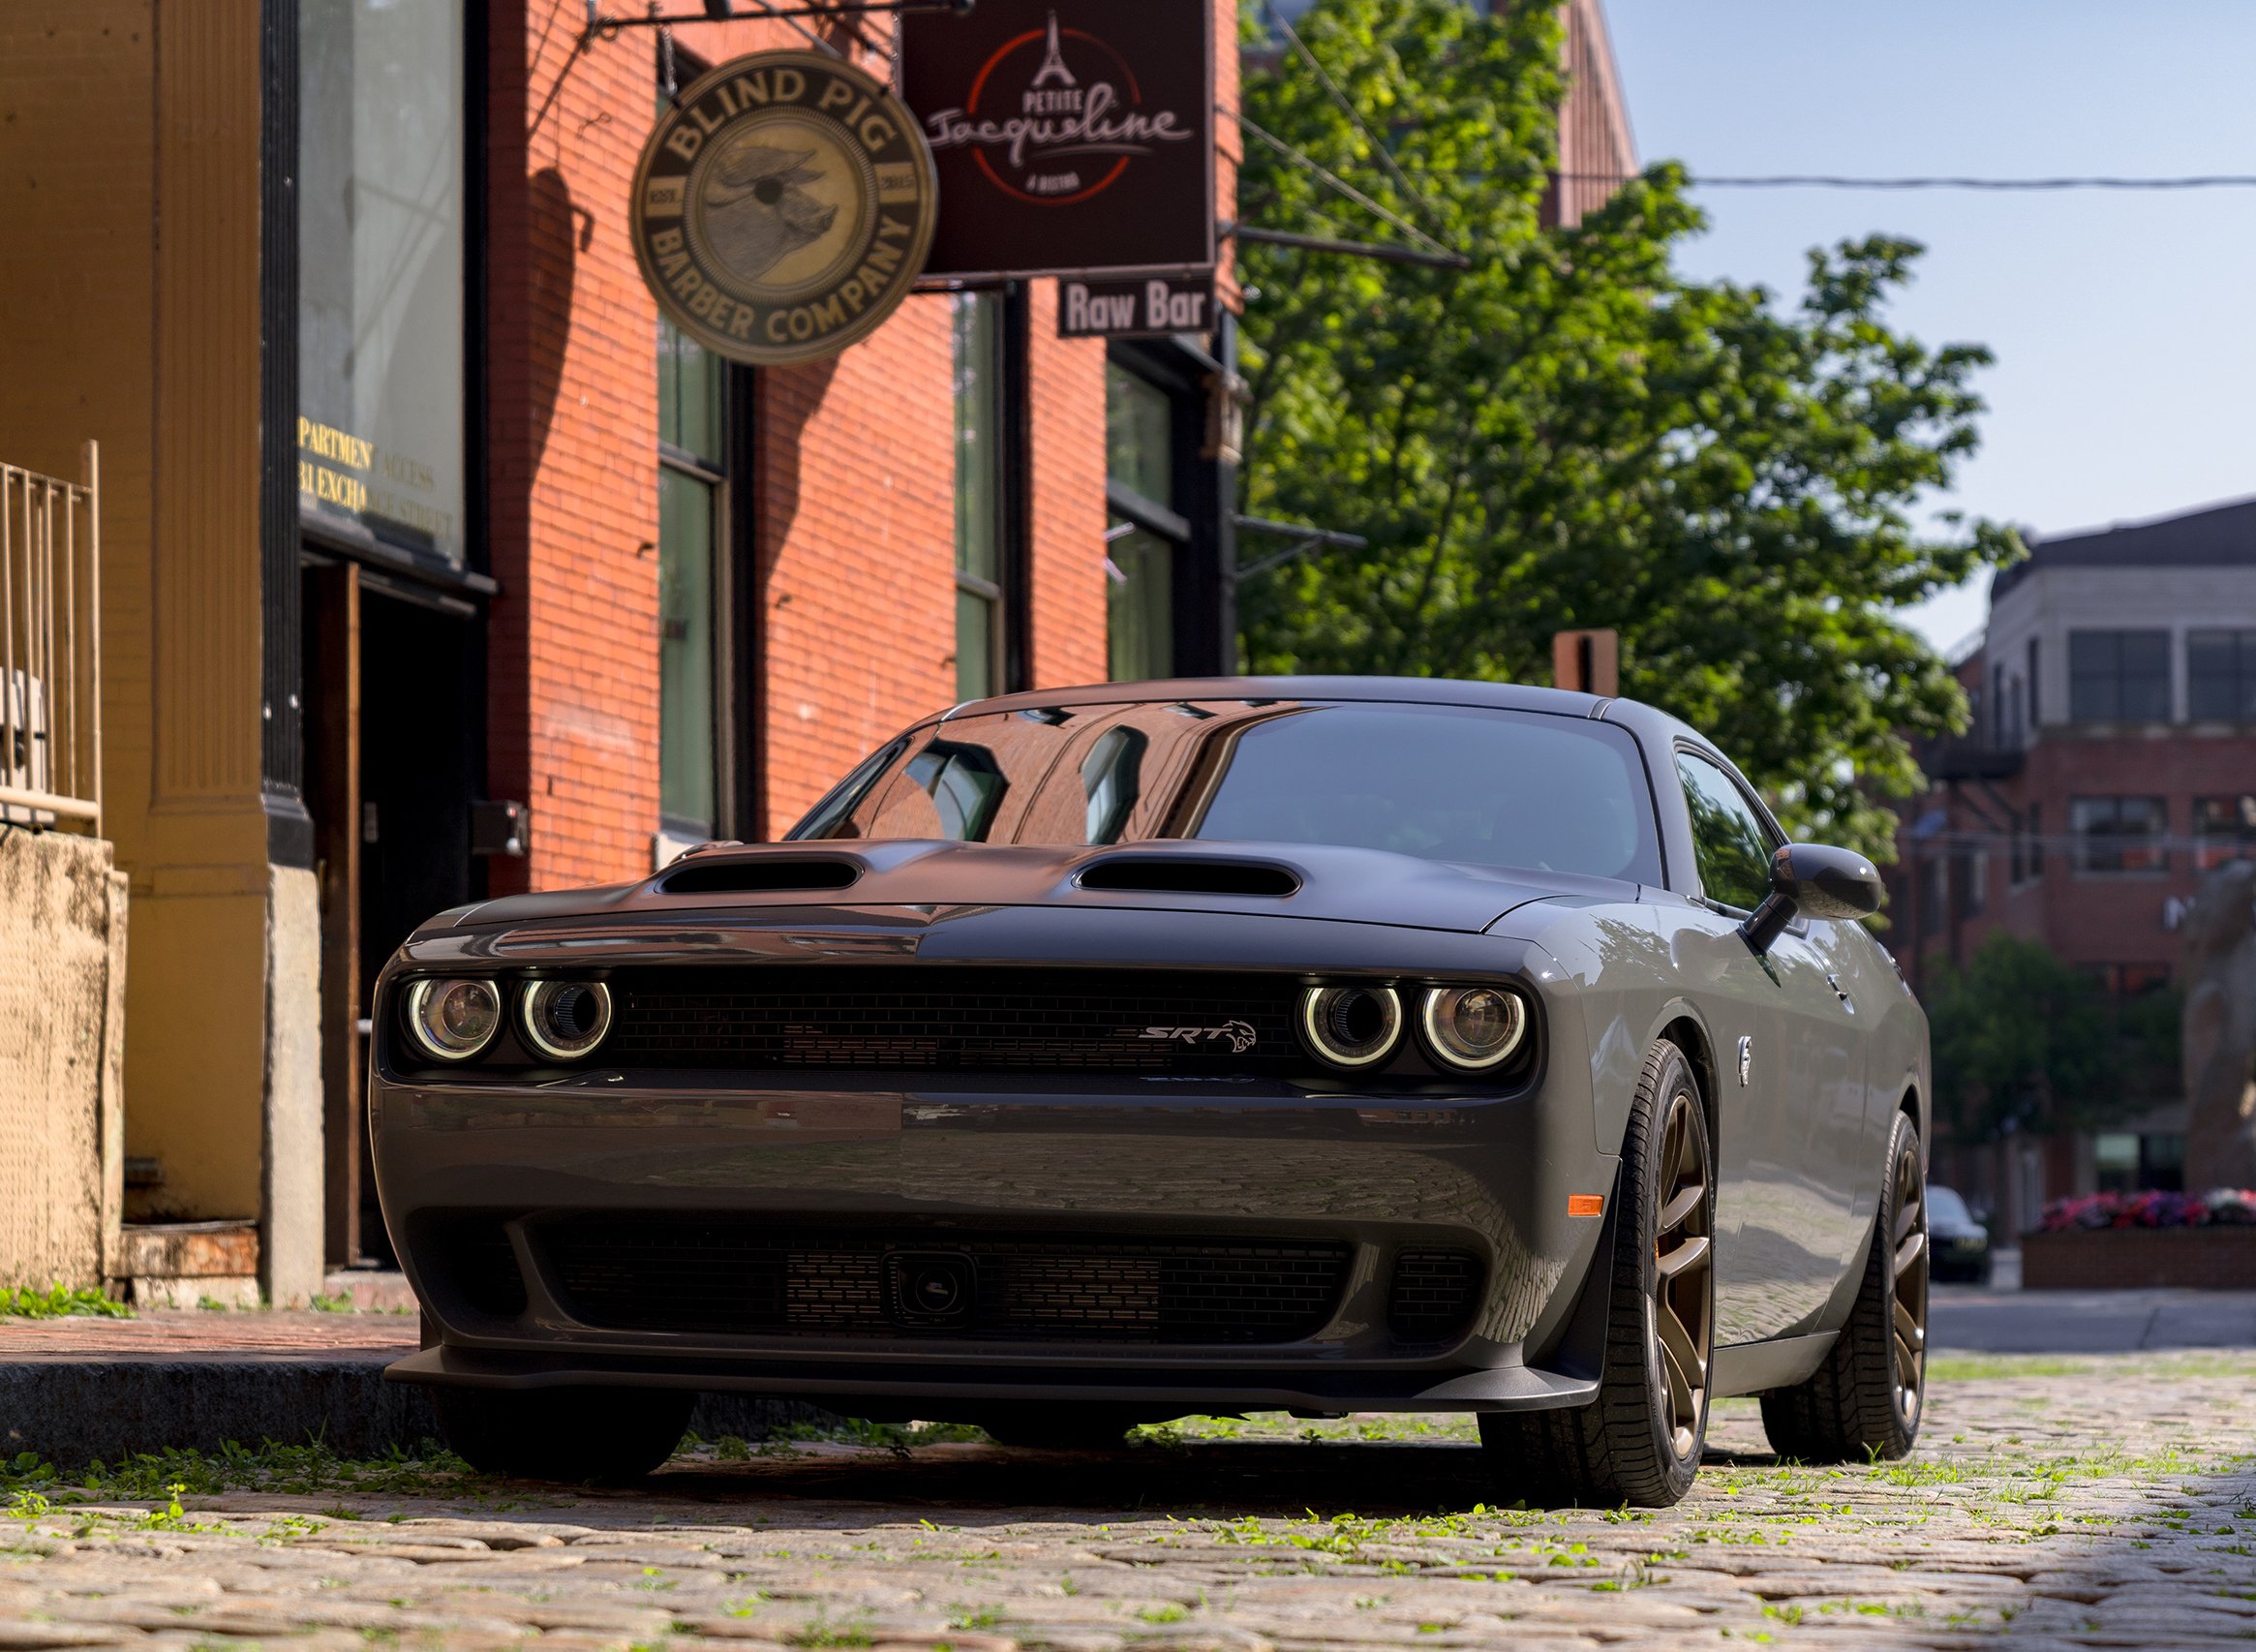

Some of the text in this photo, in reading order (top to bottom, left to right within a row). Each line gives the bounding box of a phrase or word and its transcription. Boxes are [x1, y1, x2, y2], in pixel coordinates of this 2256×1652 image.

[665, 69, 898, 163] BLIND PIG
[927, 82, 1193, 168] Jacqueline
[1022, 89, 1084, 113] PETITE
[651, 214, 911, 342] BARBER COMPANY
[1067, 279, 1206, 331] Raw Bar
[297, 415, 379, 473] PARTMENT
[1139, 1026, 1233, 1044] SRT
